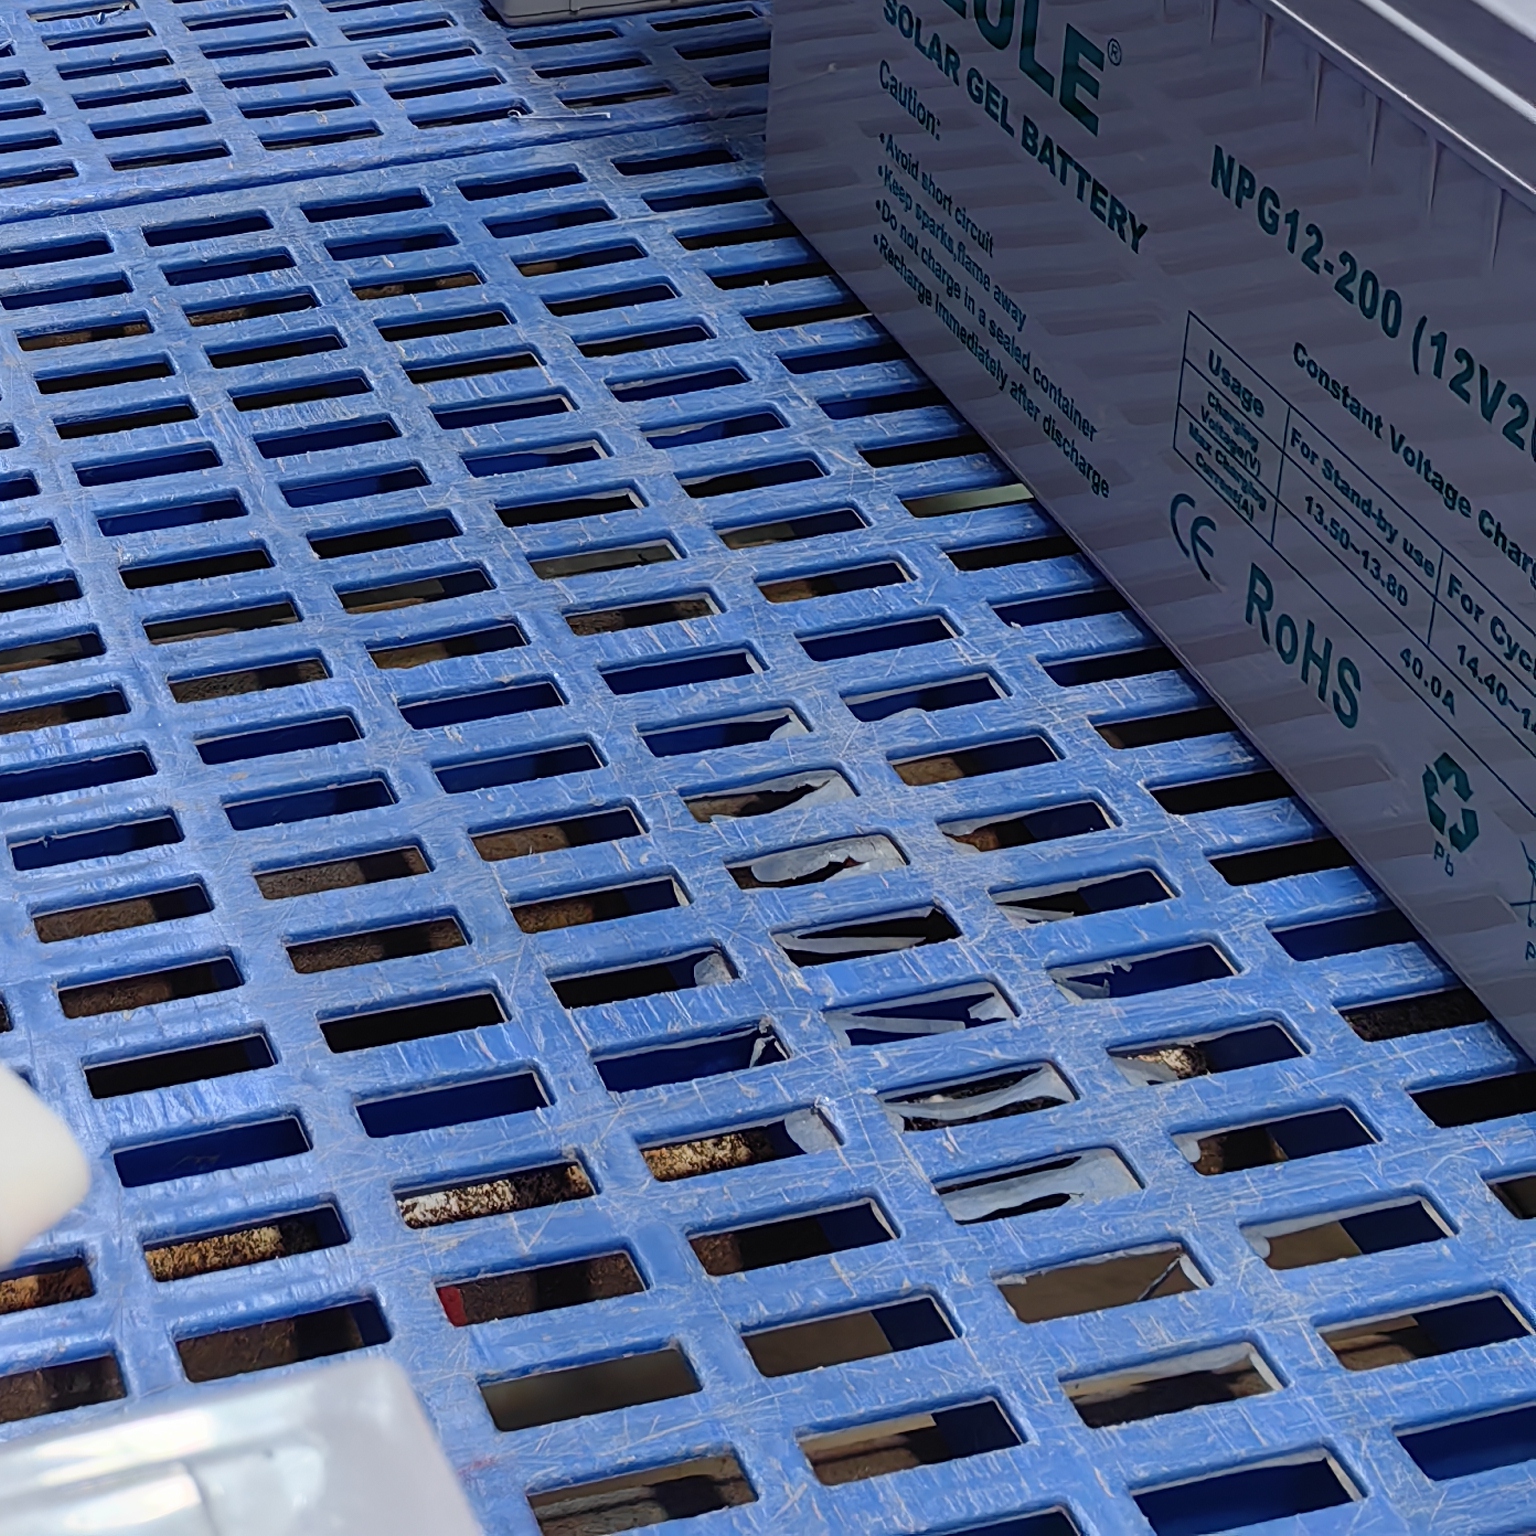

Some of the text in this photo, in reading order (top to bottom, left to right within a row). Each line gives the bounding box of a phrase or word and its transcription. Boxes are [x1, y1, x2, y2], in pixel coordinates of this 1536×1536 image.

[879, 59, 941, 141] Caution:
[966, 67, 1015, 139] GEL
[1021, 114, 1148, 255] BATTERY
[883, 165, 913, 213] Keep
[993, 284, 1027, 332] away
[885, 134, 994, 258] Avoid short circuit
[1210, 144, 1402, 339] NPG12-200
[878, 233, 932, 308] Recharge
[1010, 380, 1040, 423] after
[1042, 414, 1110, 499] discharge
[880, 198, 1098, 443] Do not charge in a sealed container
[1207, 391, 1259, 452] Charging
[1208, 349, 1265, 418] Usage
[1293, 342, 1384, 442] Constant
[1389, 424, 1473, 519] Voltage
[1291, 427, 1436, 578] For Stand-by use
[1304, 496, 1409, 607] 13.50~13.80
[1245, 564, 1362, 728] RoHS
[1447, 572, 1485, 624] For
[1400, 647, 1456, 717] 40.0A
[1456, 643, 1536, 736] 14.40~1
[1434, 840, 1455, 878] Pb
